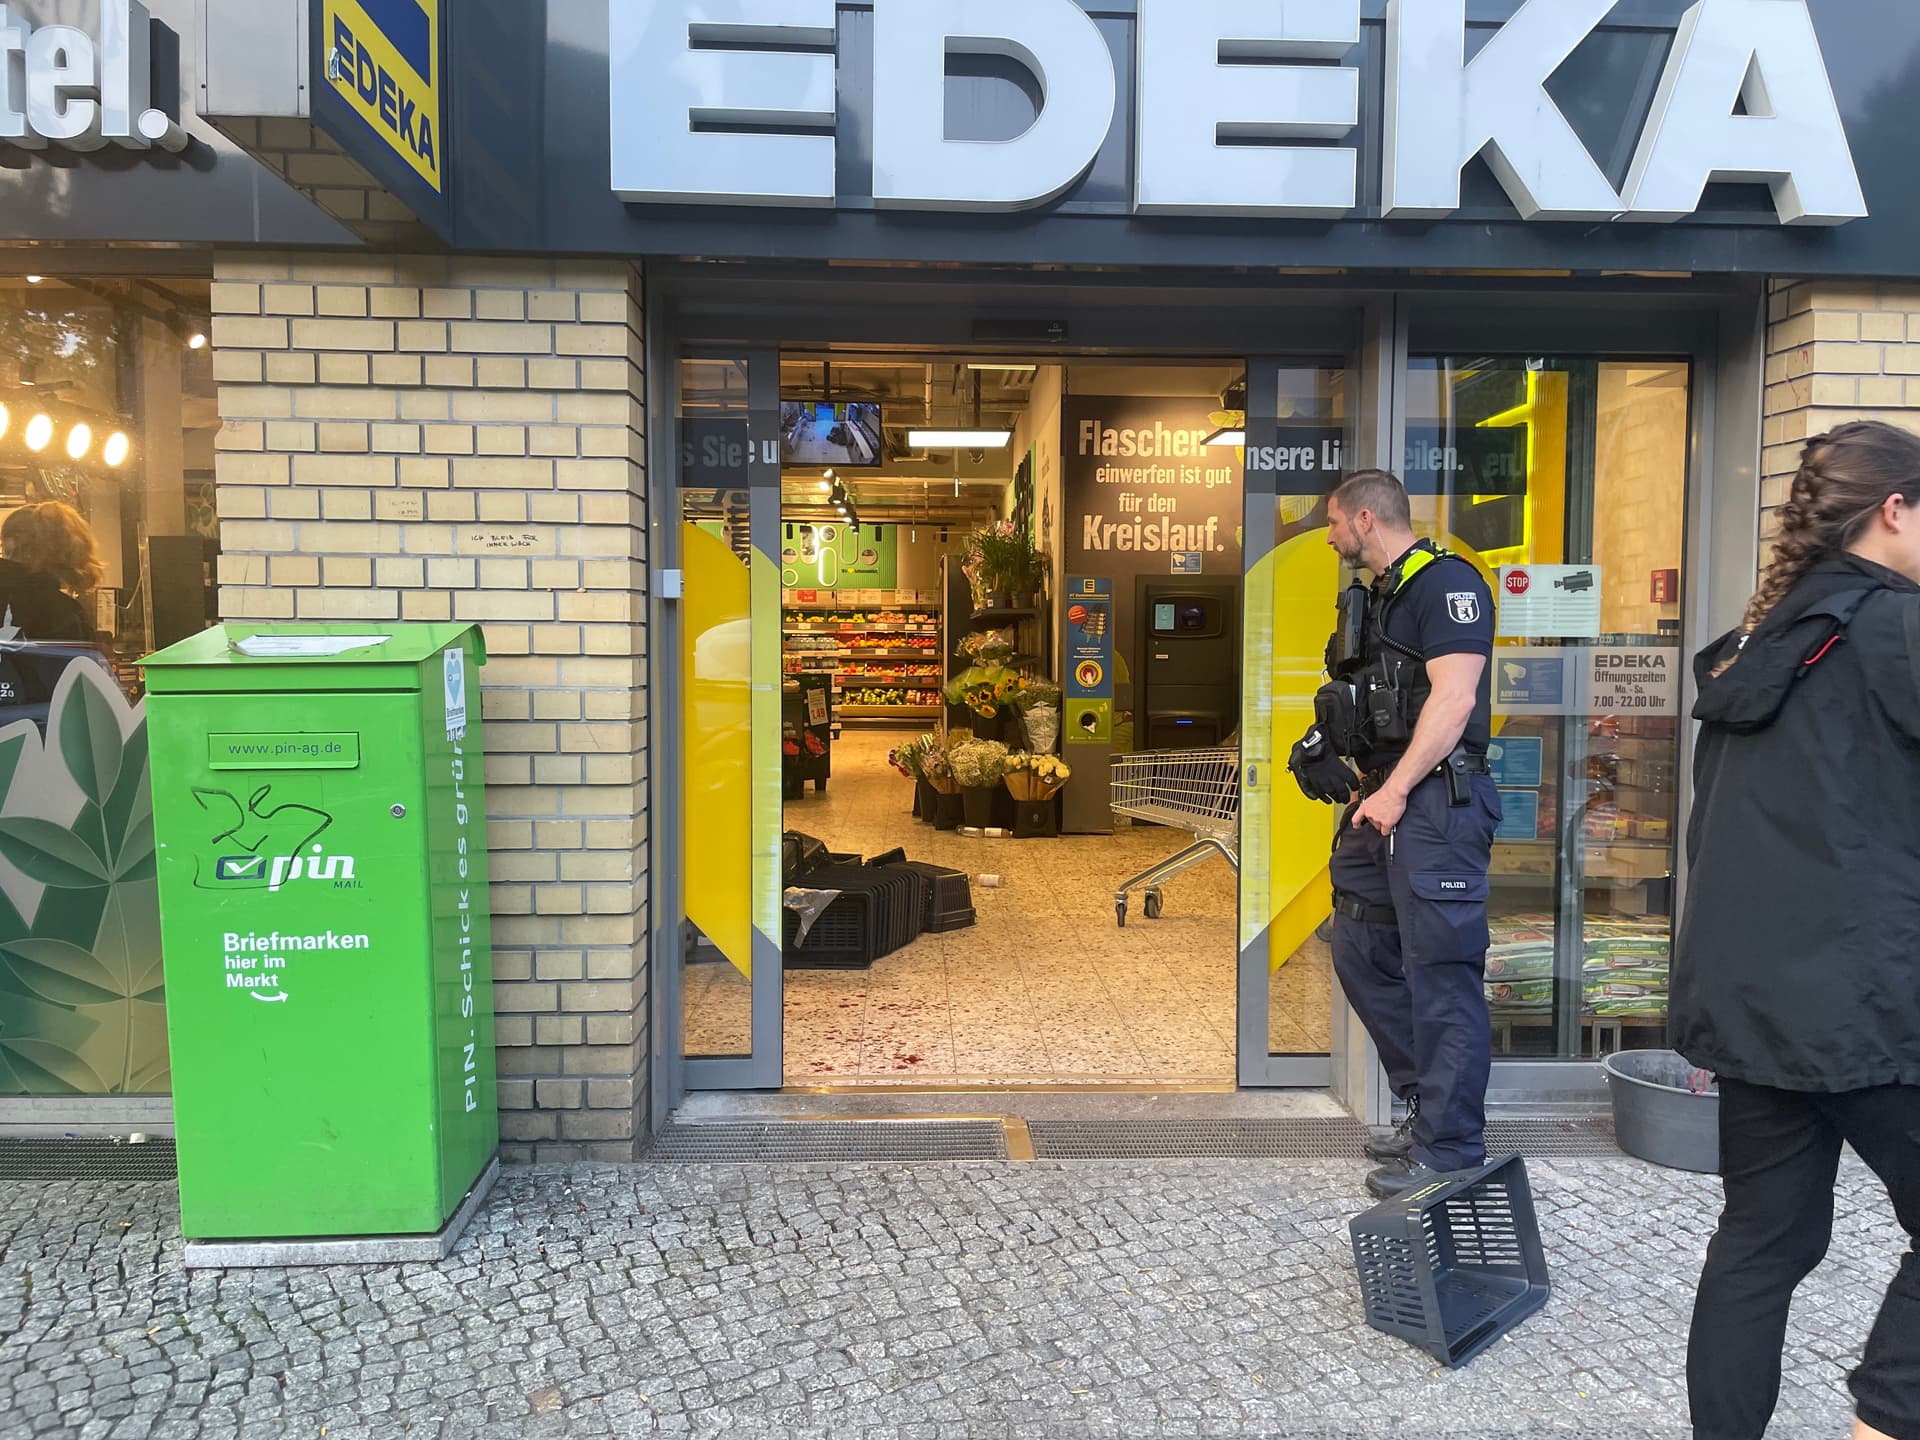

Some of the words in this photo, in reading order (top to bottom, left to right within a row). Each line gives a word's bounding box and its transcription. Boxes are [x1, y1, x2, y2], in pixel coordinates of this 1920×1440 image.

[333, 12, 436, 172] EDEKA
[610, 0, 1868, 226] EDEKA
[1079, 419, 1208, 458] Flaschen
[1095, 463, 1176, 485] einwerfen
[1179, 464, 1201, 485] ist
[1205, 465, 1233, 489] gut
[1118, 492, 1143, 513] für
[1147, 492, 1177, 513] den
[1083, 514, 1225, 552] Kreislauf.
[1506, 575, 1529, 588] STOP
[1594, 654, 1666, 668] EDEKA
[1594, 668, 1666, 685] Öffnungszeiten
[1649, 695, 1666, 708] Uhr
[228, 742, 342, 756] www.pin-ag.de
[268, 843, 355, 891] pin
[457, 837, 468, 878] es
[333, 881, 364, 889] MAIL
[1440, 881, 1466, 889] POLIZEI
[223, 931, 369, 952] Briefmarken
[224, 954, 257, 969] hier
[264, 954, 285, 969] im
[457, 888, 474, 1019] Schick
[226, 972, 279, 988] Markt
